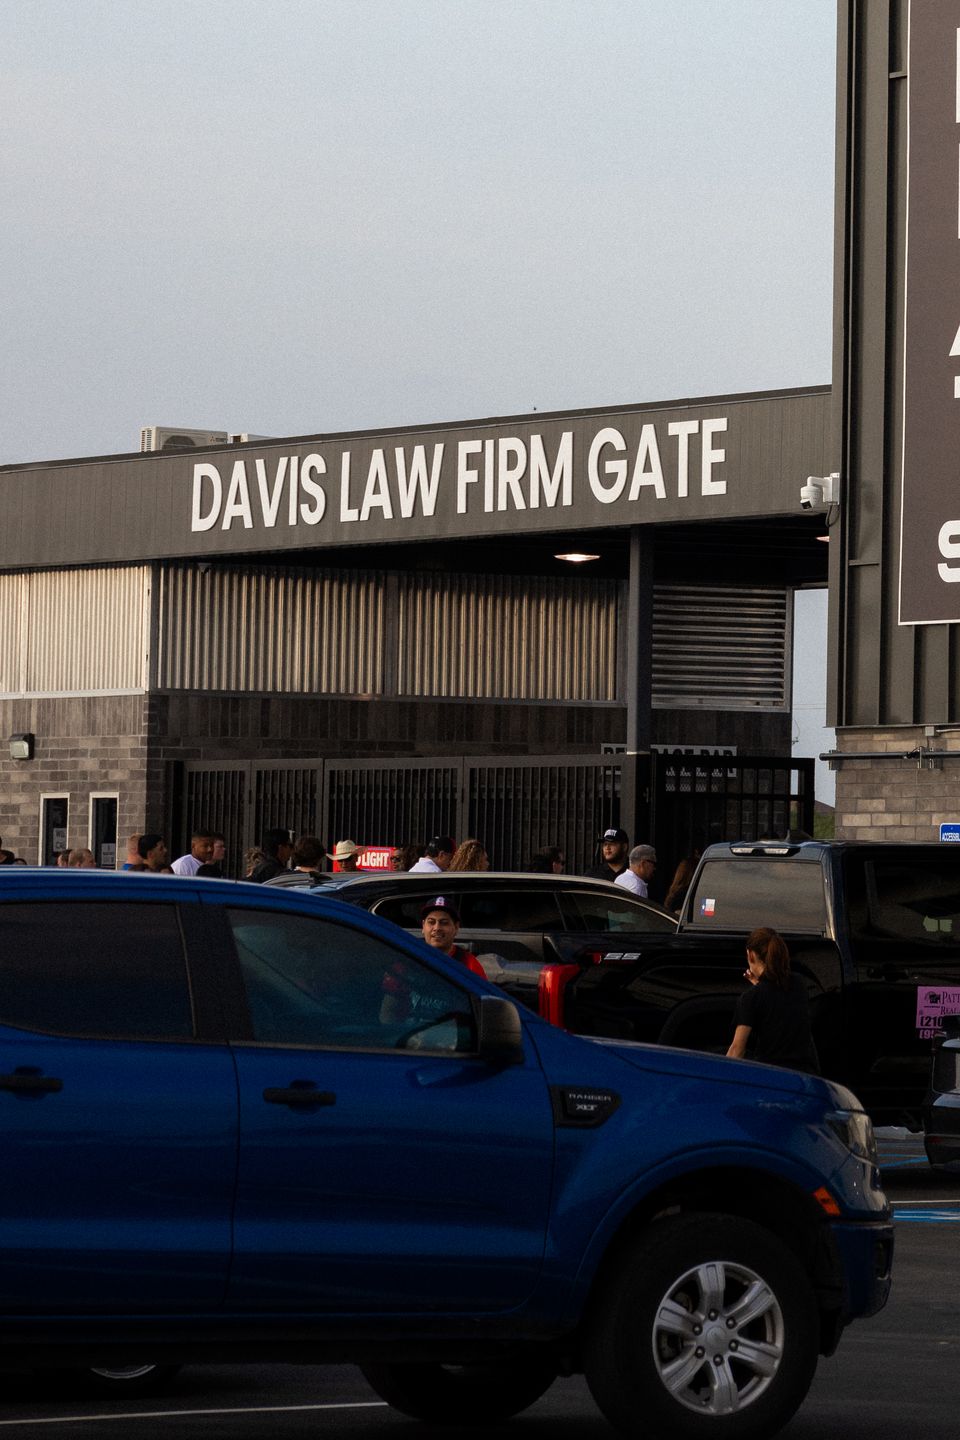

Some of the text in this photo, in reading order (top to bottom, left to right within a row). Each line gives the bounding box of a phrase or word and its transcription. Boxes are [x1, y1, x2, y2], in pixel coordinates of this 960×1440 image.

[191, 417, 728, 532] DAVIS LAW FIRM GATE
[568, 1093, 612, 1102] RANGER
